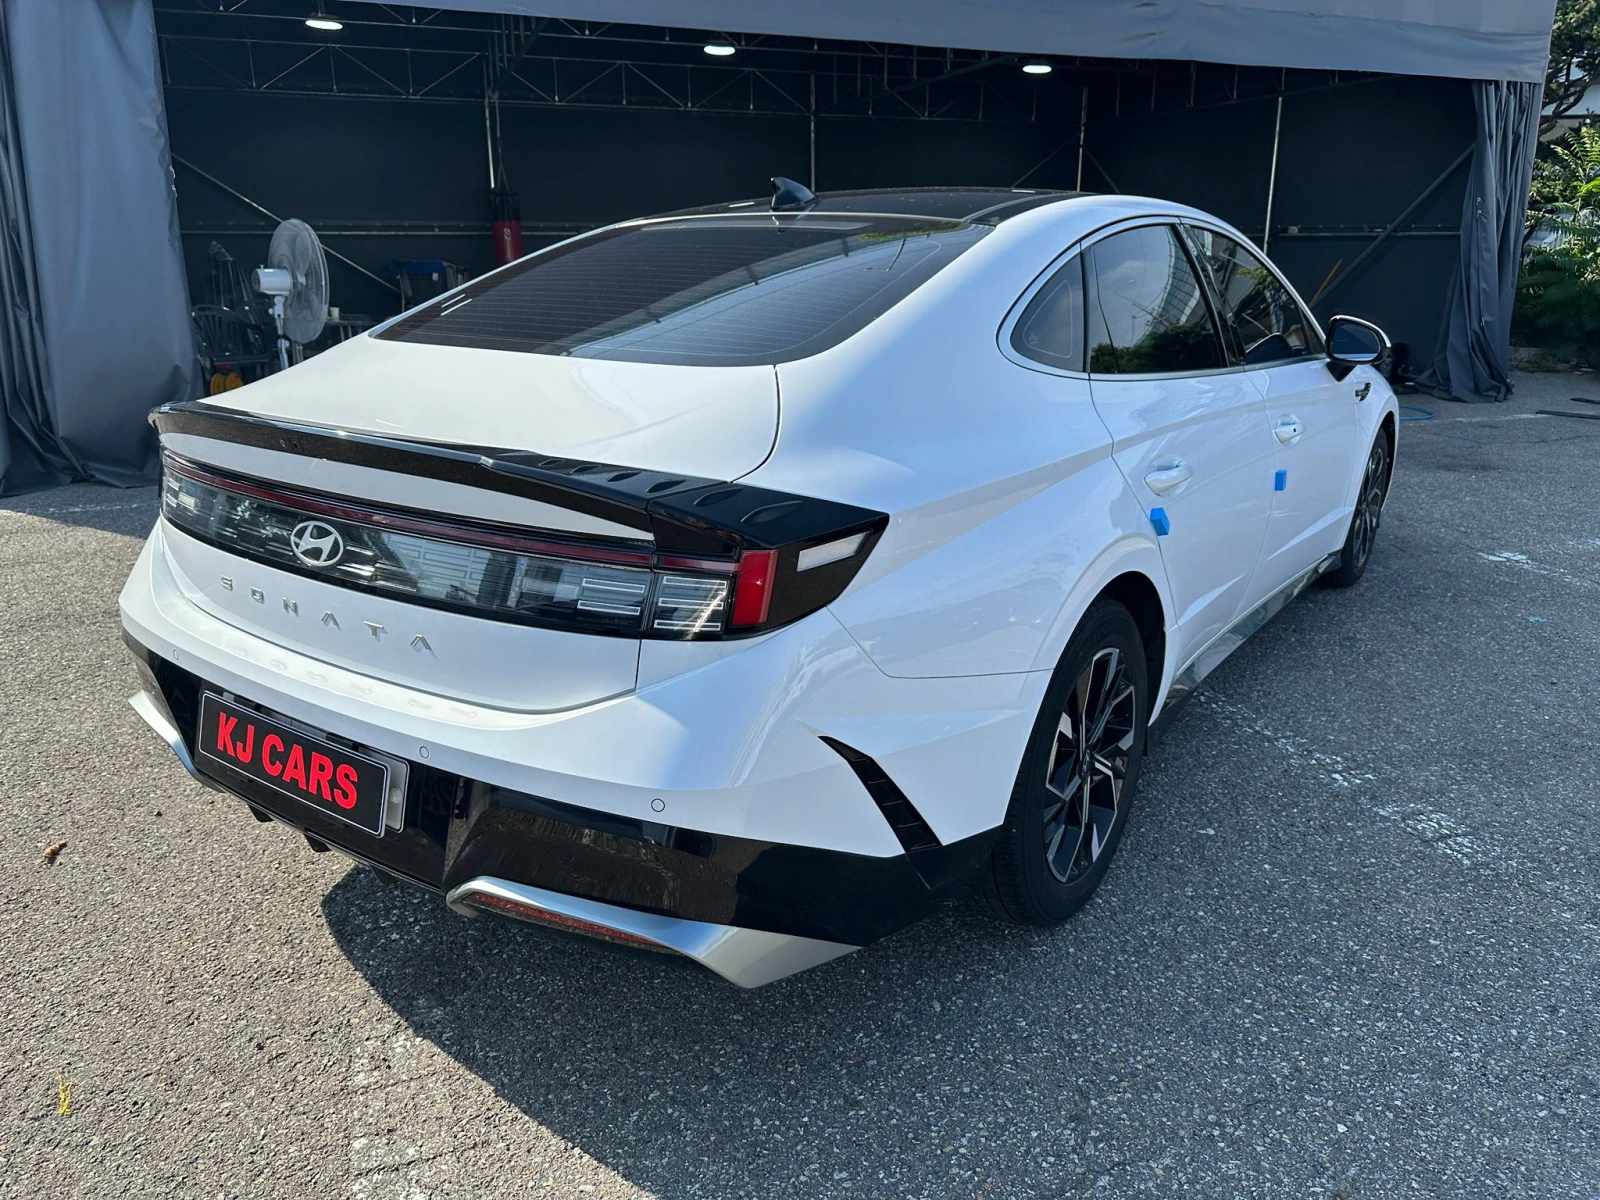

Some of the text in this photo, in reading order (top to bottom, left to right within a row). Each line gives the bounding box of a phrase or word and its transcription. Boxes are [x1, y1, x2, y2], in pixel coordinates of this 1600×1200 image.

[220, 576, 433, 651] SONATA
[217, 711, 358, 809] KJ CARS
